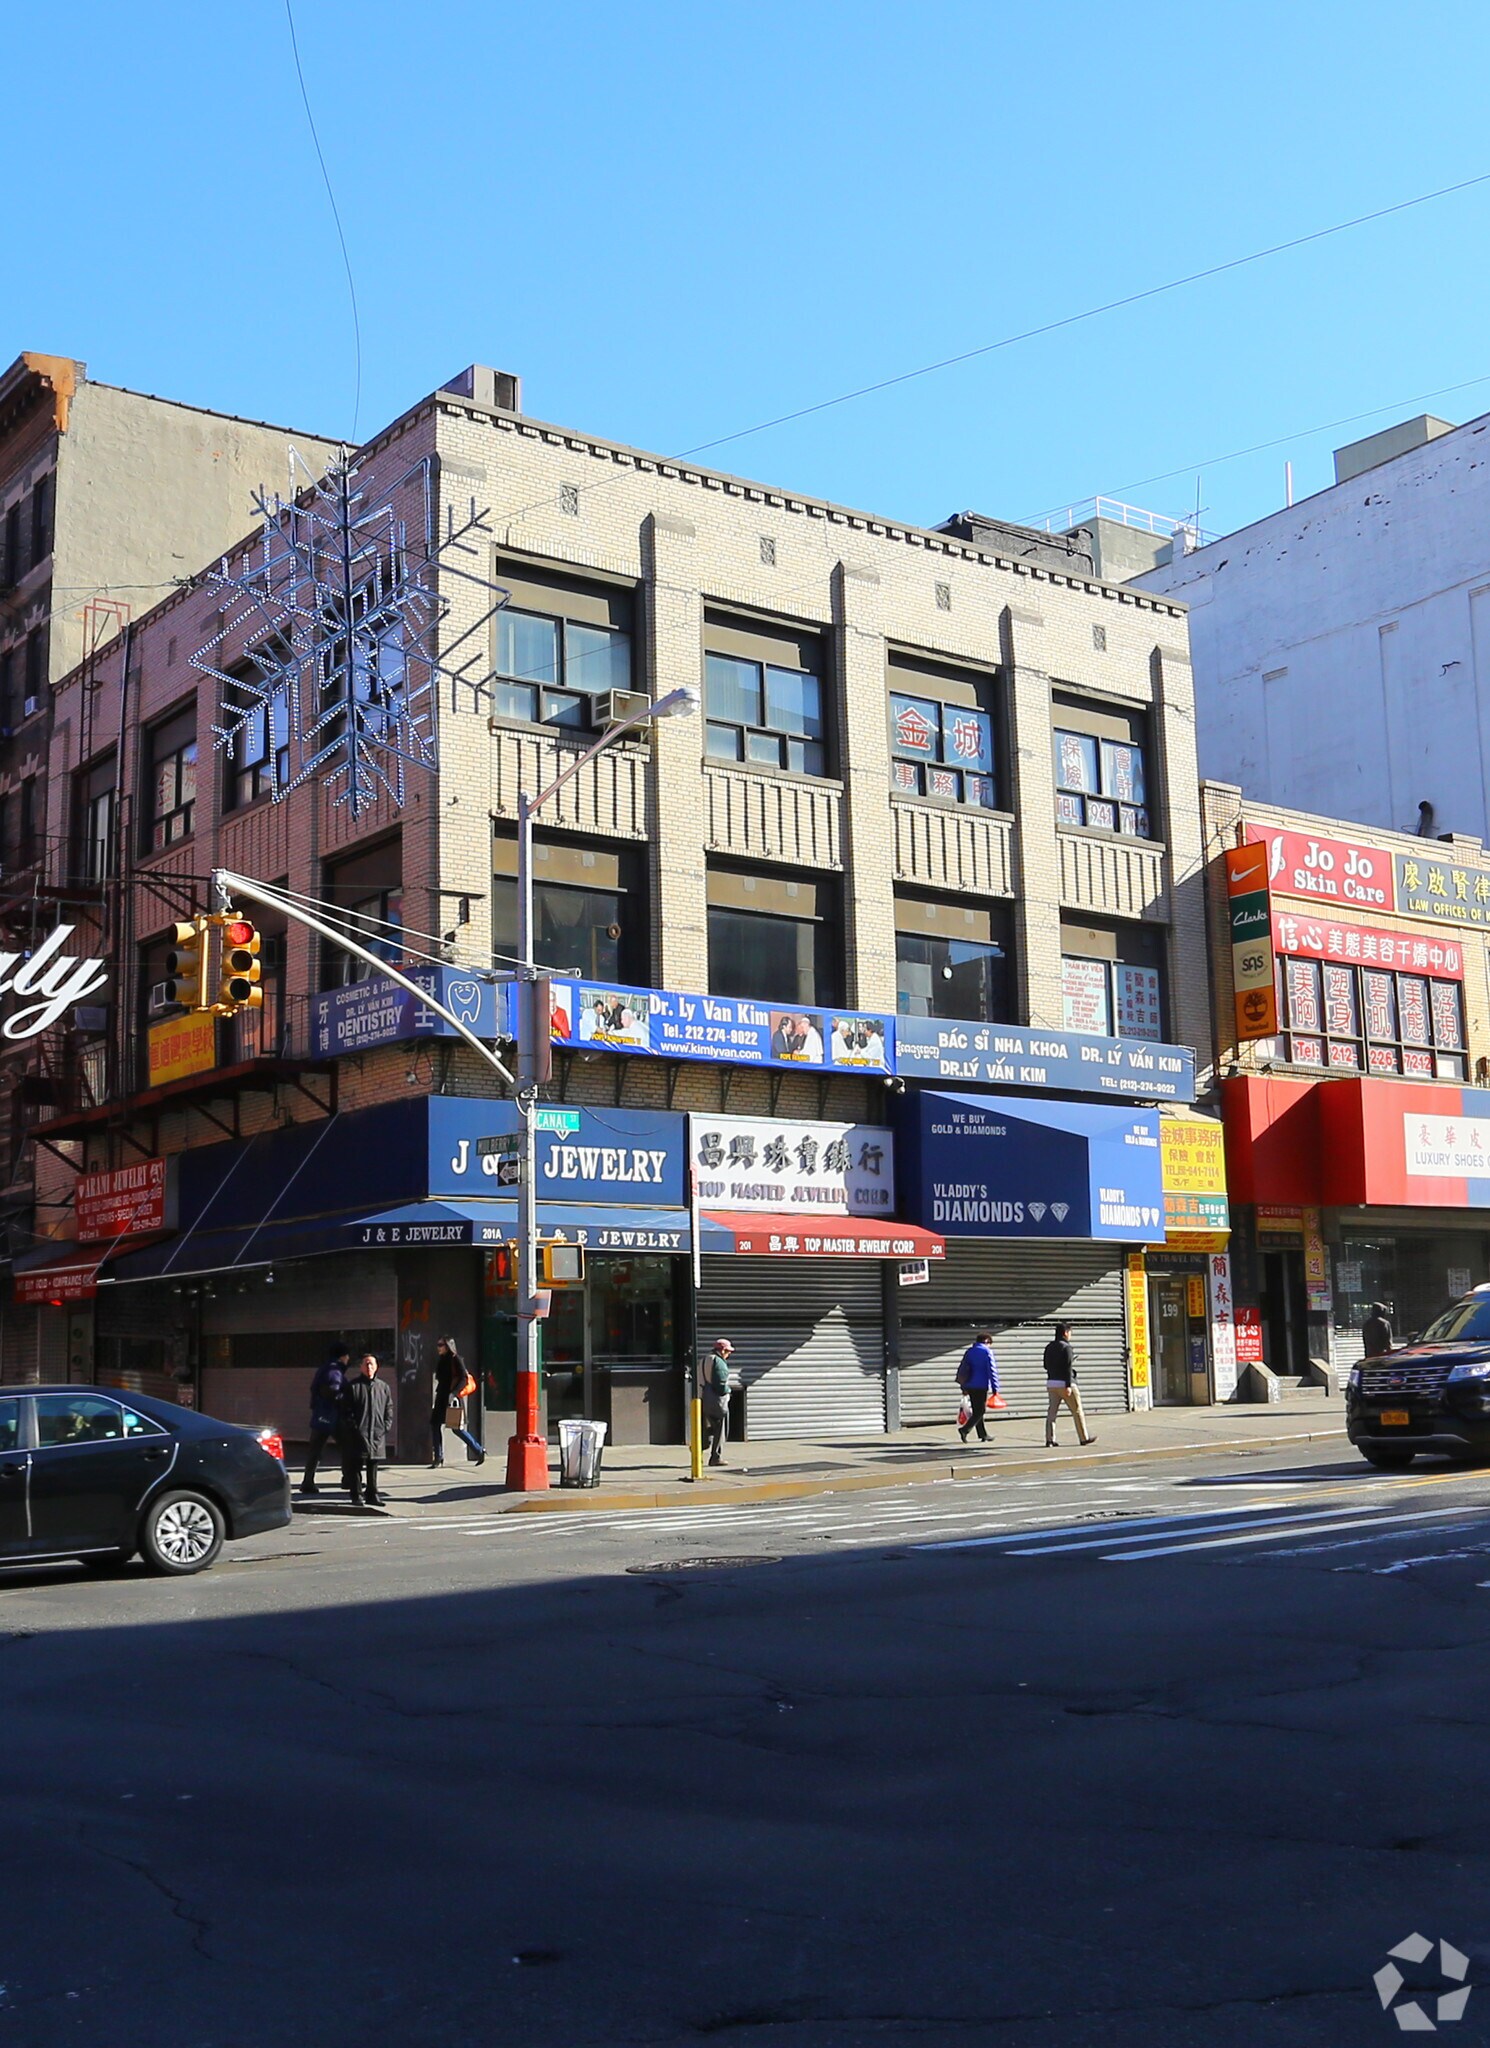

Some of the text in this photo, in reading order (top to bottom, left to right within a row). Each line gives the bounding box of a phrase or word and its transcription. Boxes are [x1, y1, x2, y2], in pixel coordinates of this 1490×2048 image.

[897, 708, 984, 760] 金城
[1061, 736, 1082, 789] 保險
[1115, 747, 1133, 799] 會計
[896, 764, 989, 801] 事務所
[1090, 803, 1112, 825] 941
[1304, 841, 1373, 878] Jo Jo
[1294, 869, 1385, 903] Skin Care
[1233, 909, 1268, 926] Clarks
[1408, 898, 1429, 912] LAW
[1432, 903, 1467, 920] OFFICES
[1471, 908, 1483, 921] OF
[1278, 917, 1323, 952] 信心
[1242, 955, 1264, 973] SAS
[336, 983, 378, 1005] COSMETIC &
[382, 996, 394, 1009] KIM
[1134, 971, 1145, 1023] 簡森吉
[318, 1001, 329, 1025] 牙
[649, 993, 769, 1026] Dr. Ly Van Kim
[338, 1005, 404, 1039] DENTISTRY
[319, 1027, 330, 1051] 博
[662, 1022, 758, 1046] Tel. 212 274-9022
[660, 1041, 762, 1060] www.kimlyvan.com
[938, 1027, 968, 1049] BÁC
[995, 1037, 1023, 1054] NHA
[1030, 1040, 1068, 1059] KHOA
[1081, 1046, 1104, 1063] DR.
[1108, 1044, 1122, 1065] LÝ
[1128, 1046, 1154, 1070] VĂN
[1158, 1056, 1182, 1072] KIM
[1297, 1041, 1320, 1062] Tel:
[1404, 1053, 1432, 1073] 7212
[940, 1056, 1046, 1083] DR.LÝ VĂN KIM
[1100, 1076, 1176, 1095] TEL: (212)-274-9022
[537, 1113, 568, 1129] CANAL
[931, 1124, 1007, 1136] GOLD & DIAMONDS
[952, 1114, 985, 1124] WE BUY
[1132, 1125, 1149, 1135] WE BUY
[1139, 1136, 1158, 1147] DIAMONDS
[452, 1140, 470, 1175] J
[544, 1145, 666, 1183] JEWELRY
[1415, 1151, 1450, 1165] LUXURY
[1455, 1153, 1484, 1167] SHOES
[113, 1165, 147, 1192] JEWELRY
[698, 1180, 726, 1198] TOP
[731, 1181, 786, 1201] MASTER
[790, 1185, 849, 1204] JEWELRY
[933, 1183, 987, 1199] VLADDY'S
[1099, 1187, 1125, 1203] VLADDY'S
[933, 1200, 1024, 1223] DIAMONDS
[1099, 1204, 1141, 1227] DIAMONDS
[363, 1226, 464, 1242] J & E JEWELRY
[482, 1228, 502, 1240] 201A
[577, 1230, 588, 1244] E
[599, 1231, 681, 1248] JEWELRY
[768, 1235, 799, 1252] 昌興
[739, 1241, 751, 1250] 201
[804, 1237, 915, 1254] TOP MASTER JEWELRY CORP.
[931, 1244, 943, 1255] 201
[1211, 1256, 1230, 1332] 簡森吉
[1162, 1304, 1178, 1317] 199
